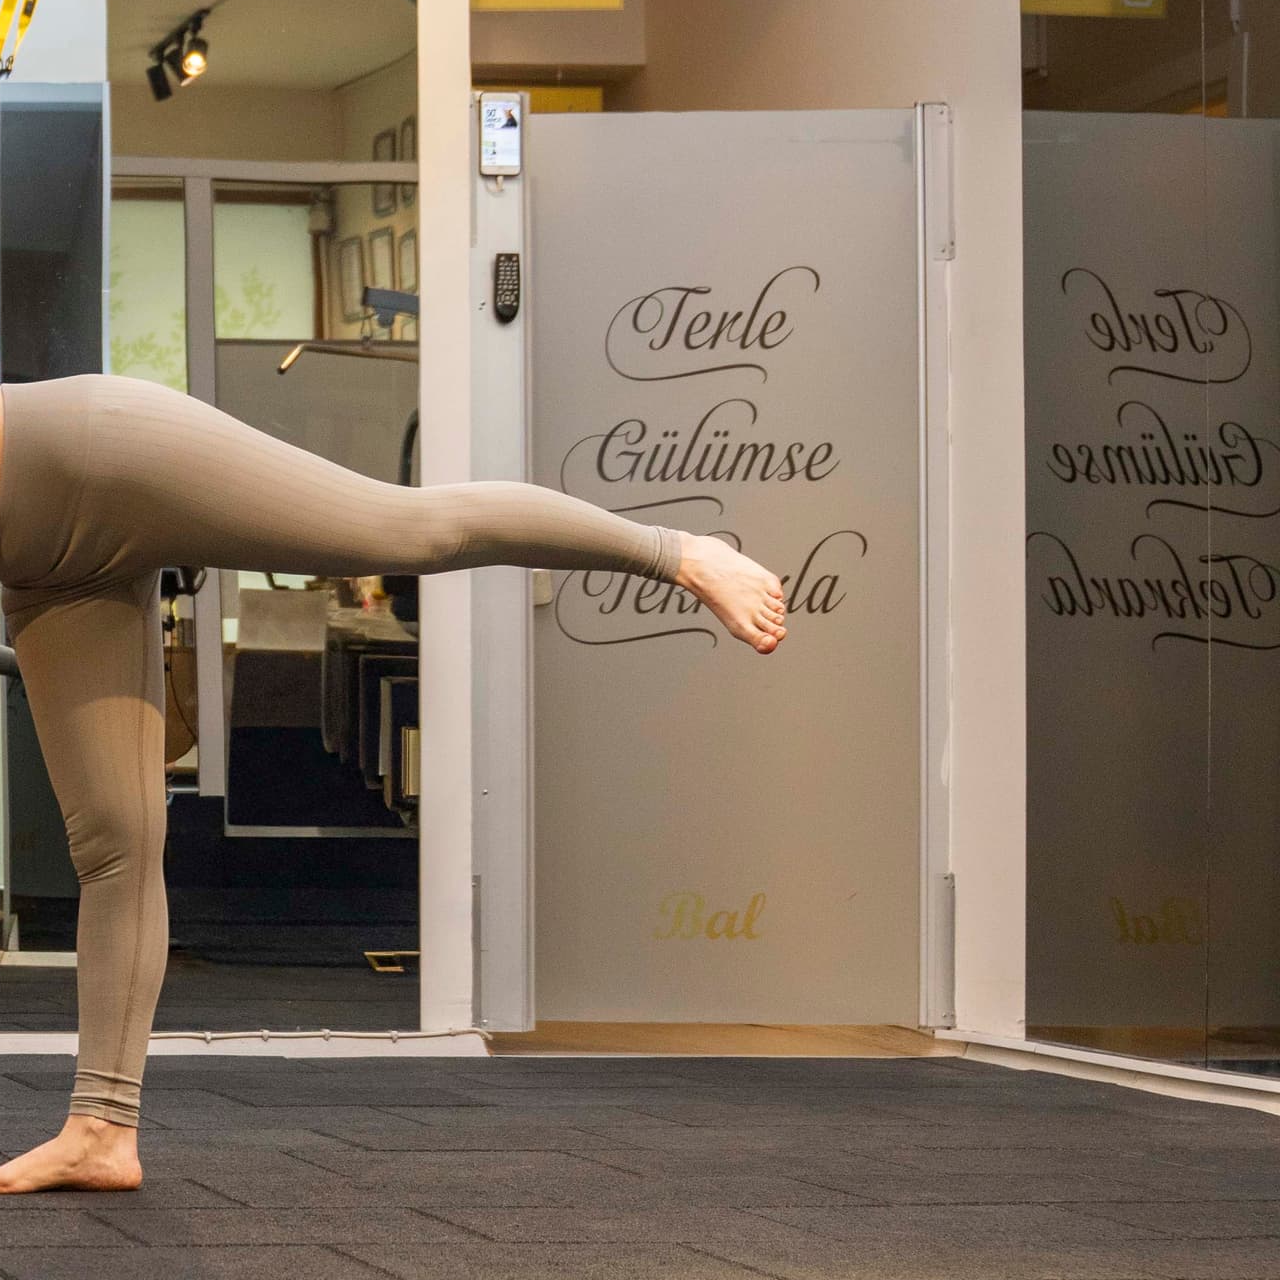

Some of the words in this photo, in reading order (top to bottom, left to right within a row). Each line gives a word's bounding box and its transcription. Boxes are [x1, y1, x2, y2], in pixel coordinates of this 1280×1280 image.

[604, 265, 821, 384] Terle
[559, 398, 841, 516] Gülümse
[652, 889, 768, 941] Bal
